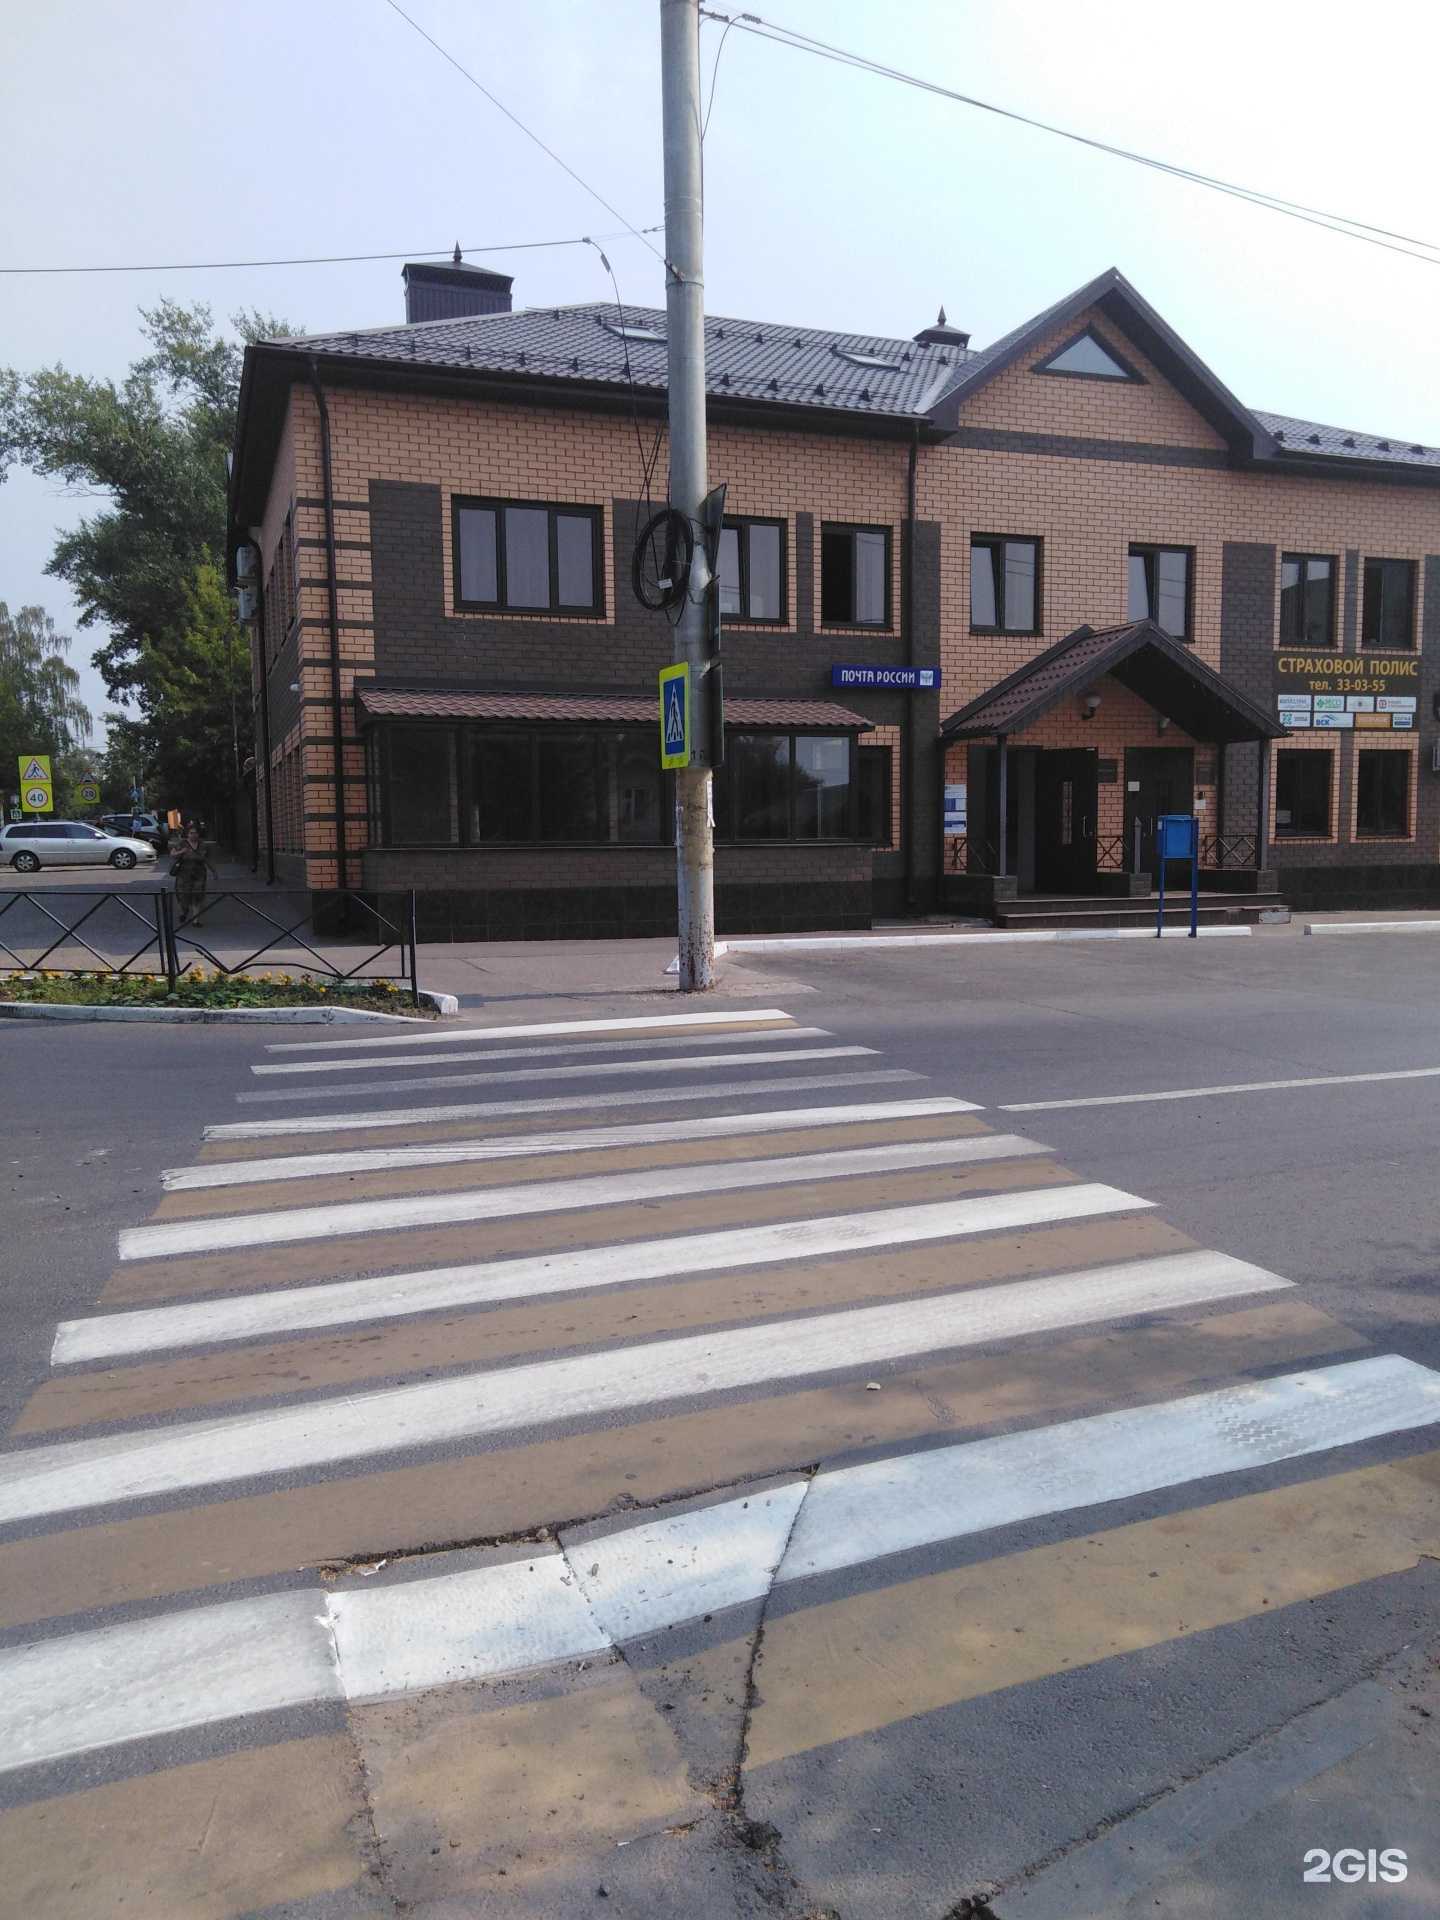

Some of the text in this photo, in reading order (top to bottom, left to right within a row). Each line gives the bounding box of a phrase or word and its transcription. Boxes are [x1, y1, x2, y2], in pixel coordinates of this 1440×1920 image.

[1278, 657, 1418, 676] СТРАХОВОЙ ПОЛИС
[841, 670, 915, 684] ПОЧТА РОССИИ
[1309, 679, 1386, 692] тел. 33-03-55
[30, 793, 43, 802] 40
